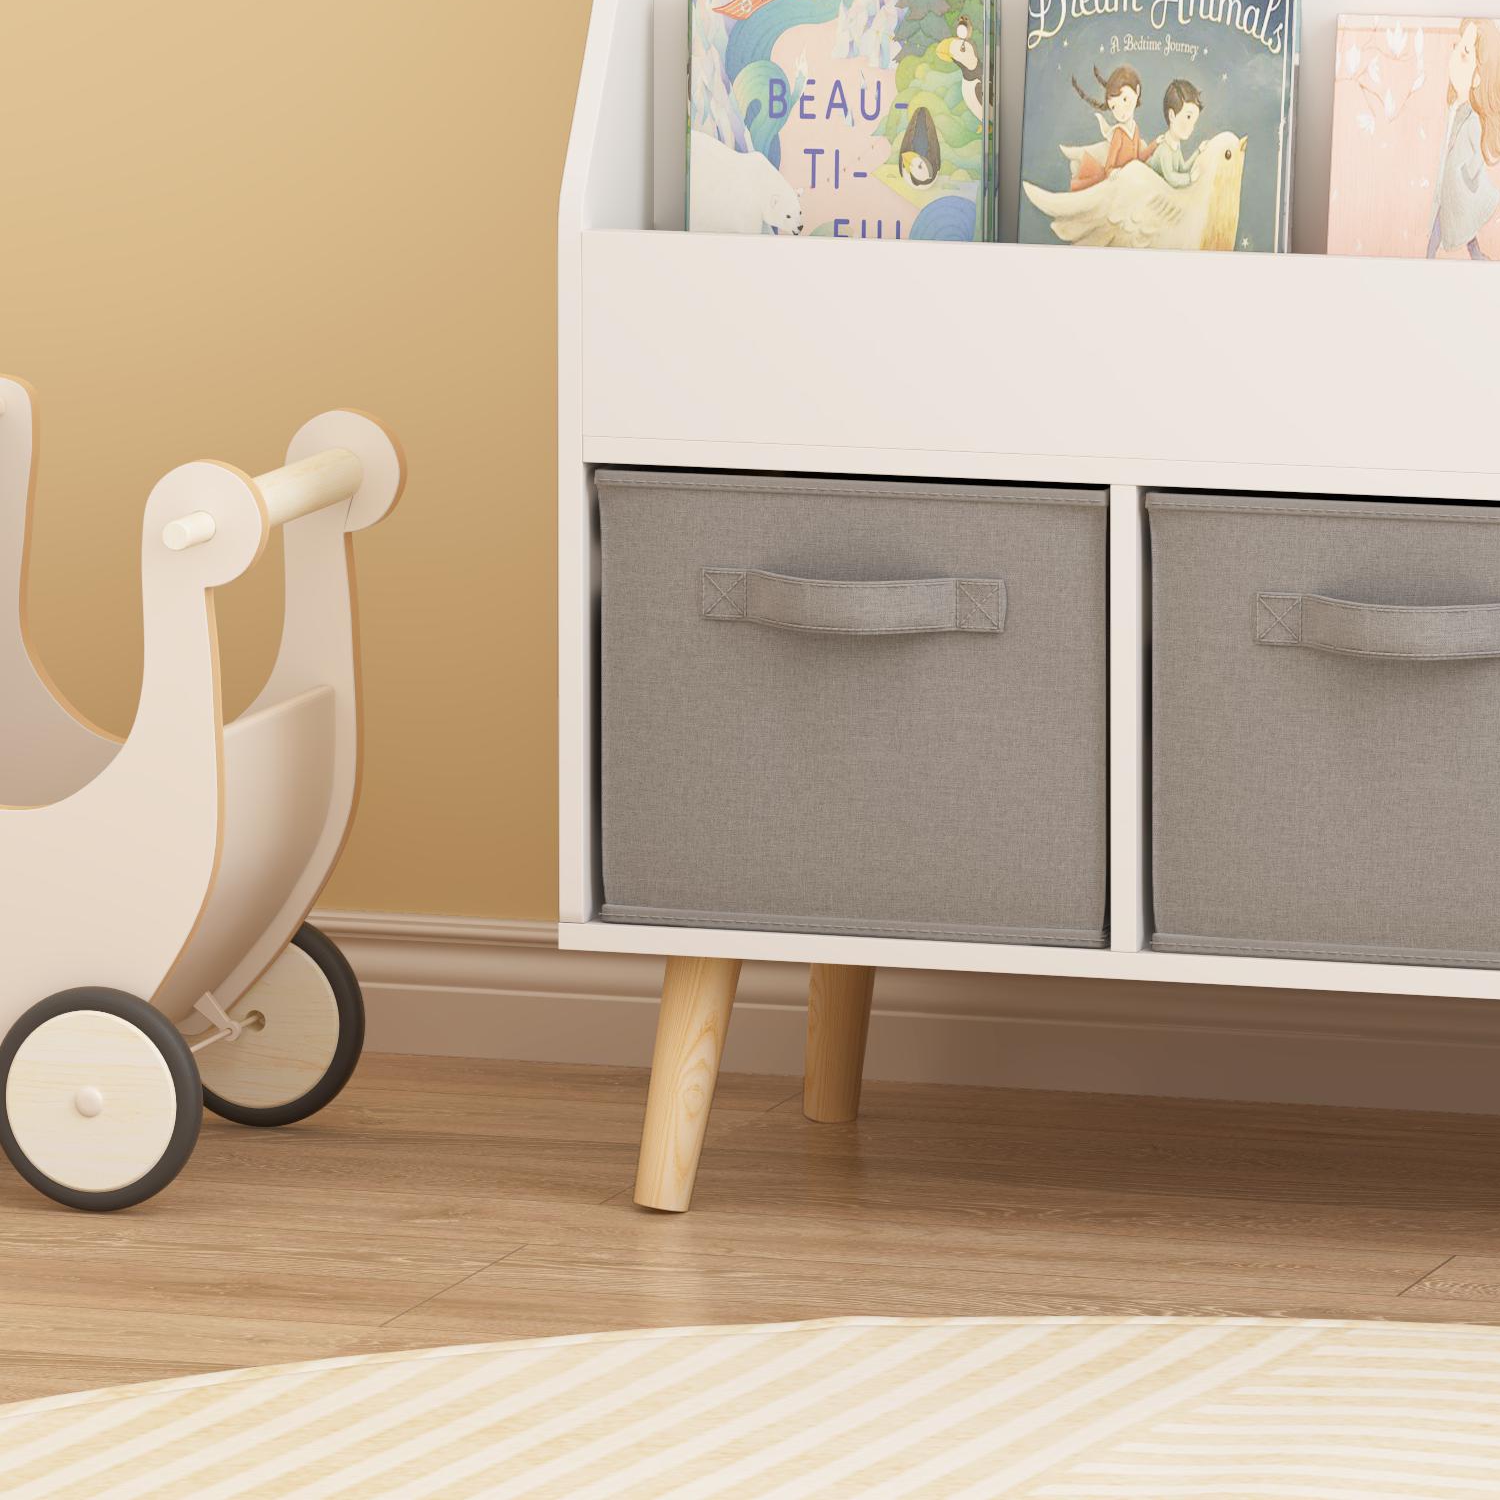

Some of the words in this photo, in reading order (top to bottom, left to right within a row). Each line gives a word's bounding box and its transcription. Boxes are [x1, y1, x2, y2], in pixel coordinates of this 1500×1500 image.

[1110, 35, 1121, 53] A
[1123, 33, 1162, 52] Bedtime
[1163, 34, 1200, 62] Journey
[768, 78, 909, 121] BEAU-
[803, 148, 867, 188] TI-
